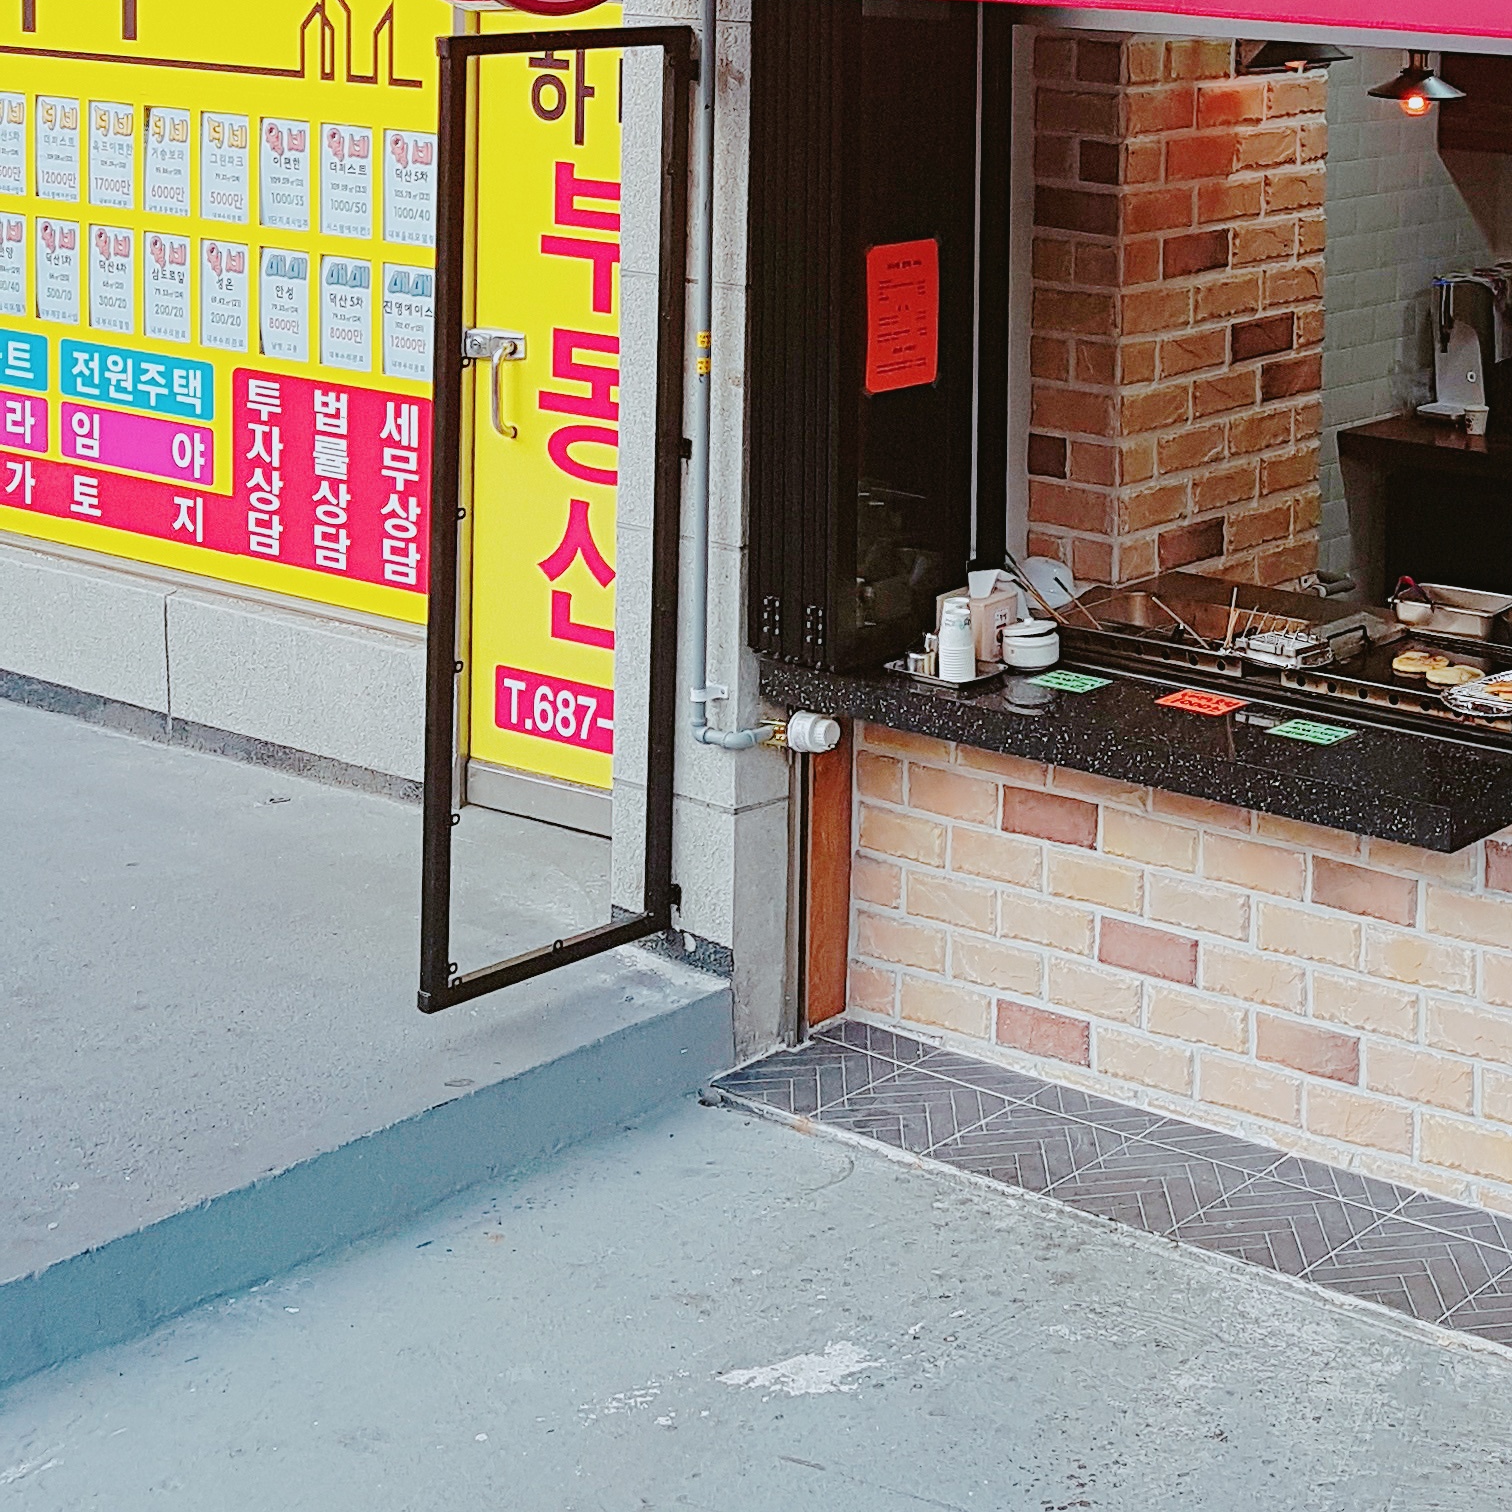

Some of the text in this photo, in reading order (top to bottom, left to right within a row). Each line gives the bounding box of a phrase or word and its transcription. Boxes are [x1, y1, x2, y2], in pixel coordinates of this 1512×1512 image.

[0, 340, 35, 380] 트
[71, 348, 203, 415] 전원주택
[245, 378, 284, 557] 투자상담
[312, 389, 351, 571] 법률상담
[380, 401, 421, 585] 세무상담
